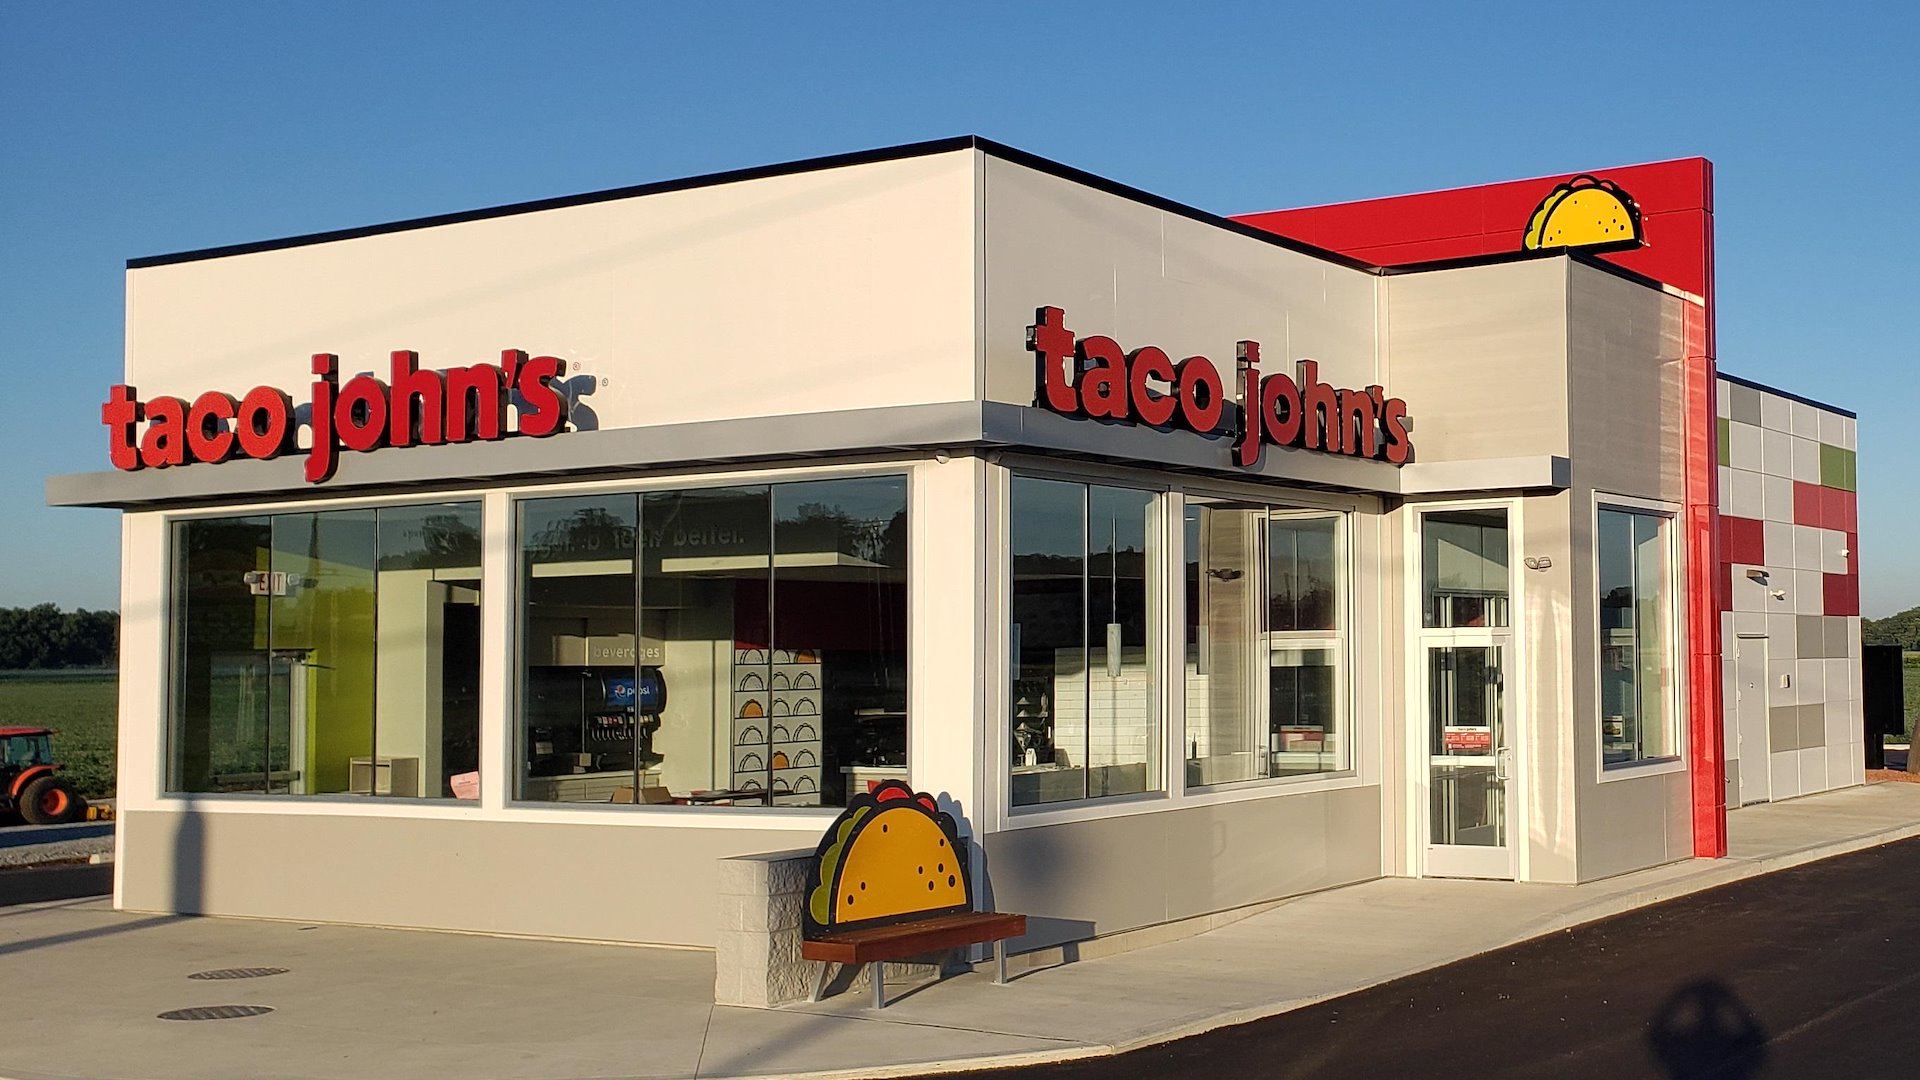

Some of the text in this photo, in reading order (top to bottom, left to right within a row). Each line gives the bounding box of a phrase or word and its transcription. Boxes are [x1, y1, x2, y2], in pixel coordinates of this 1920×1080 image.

[102, 348, 567, 483] taco john's
[1028, 305, 1410, 467] taco john's
[626, 685, 650, 698] ppsi
